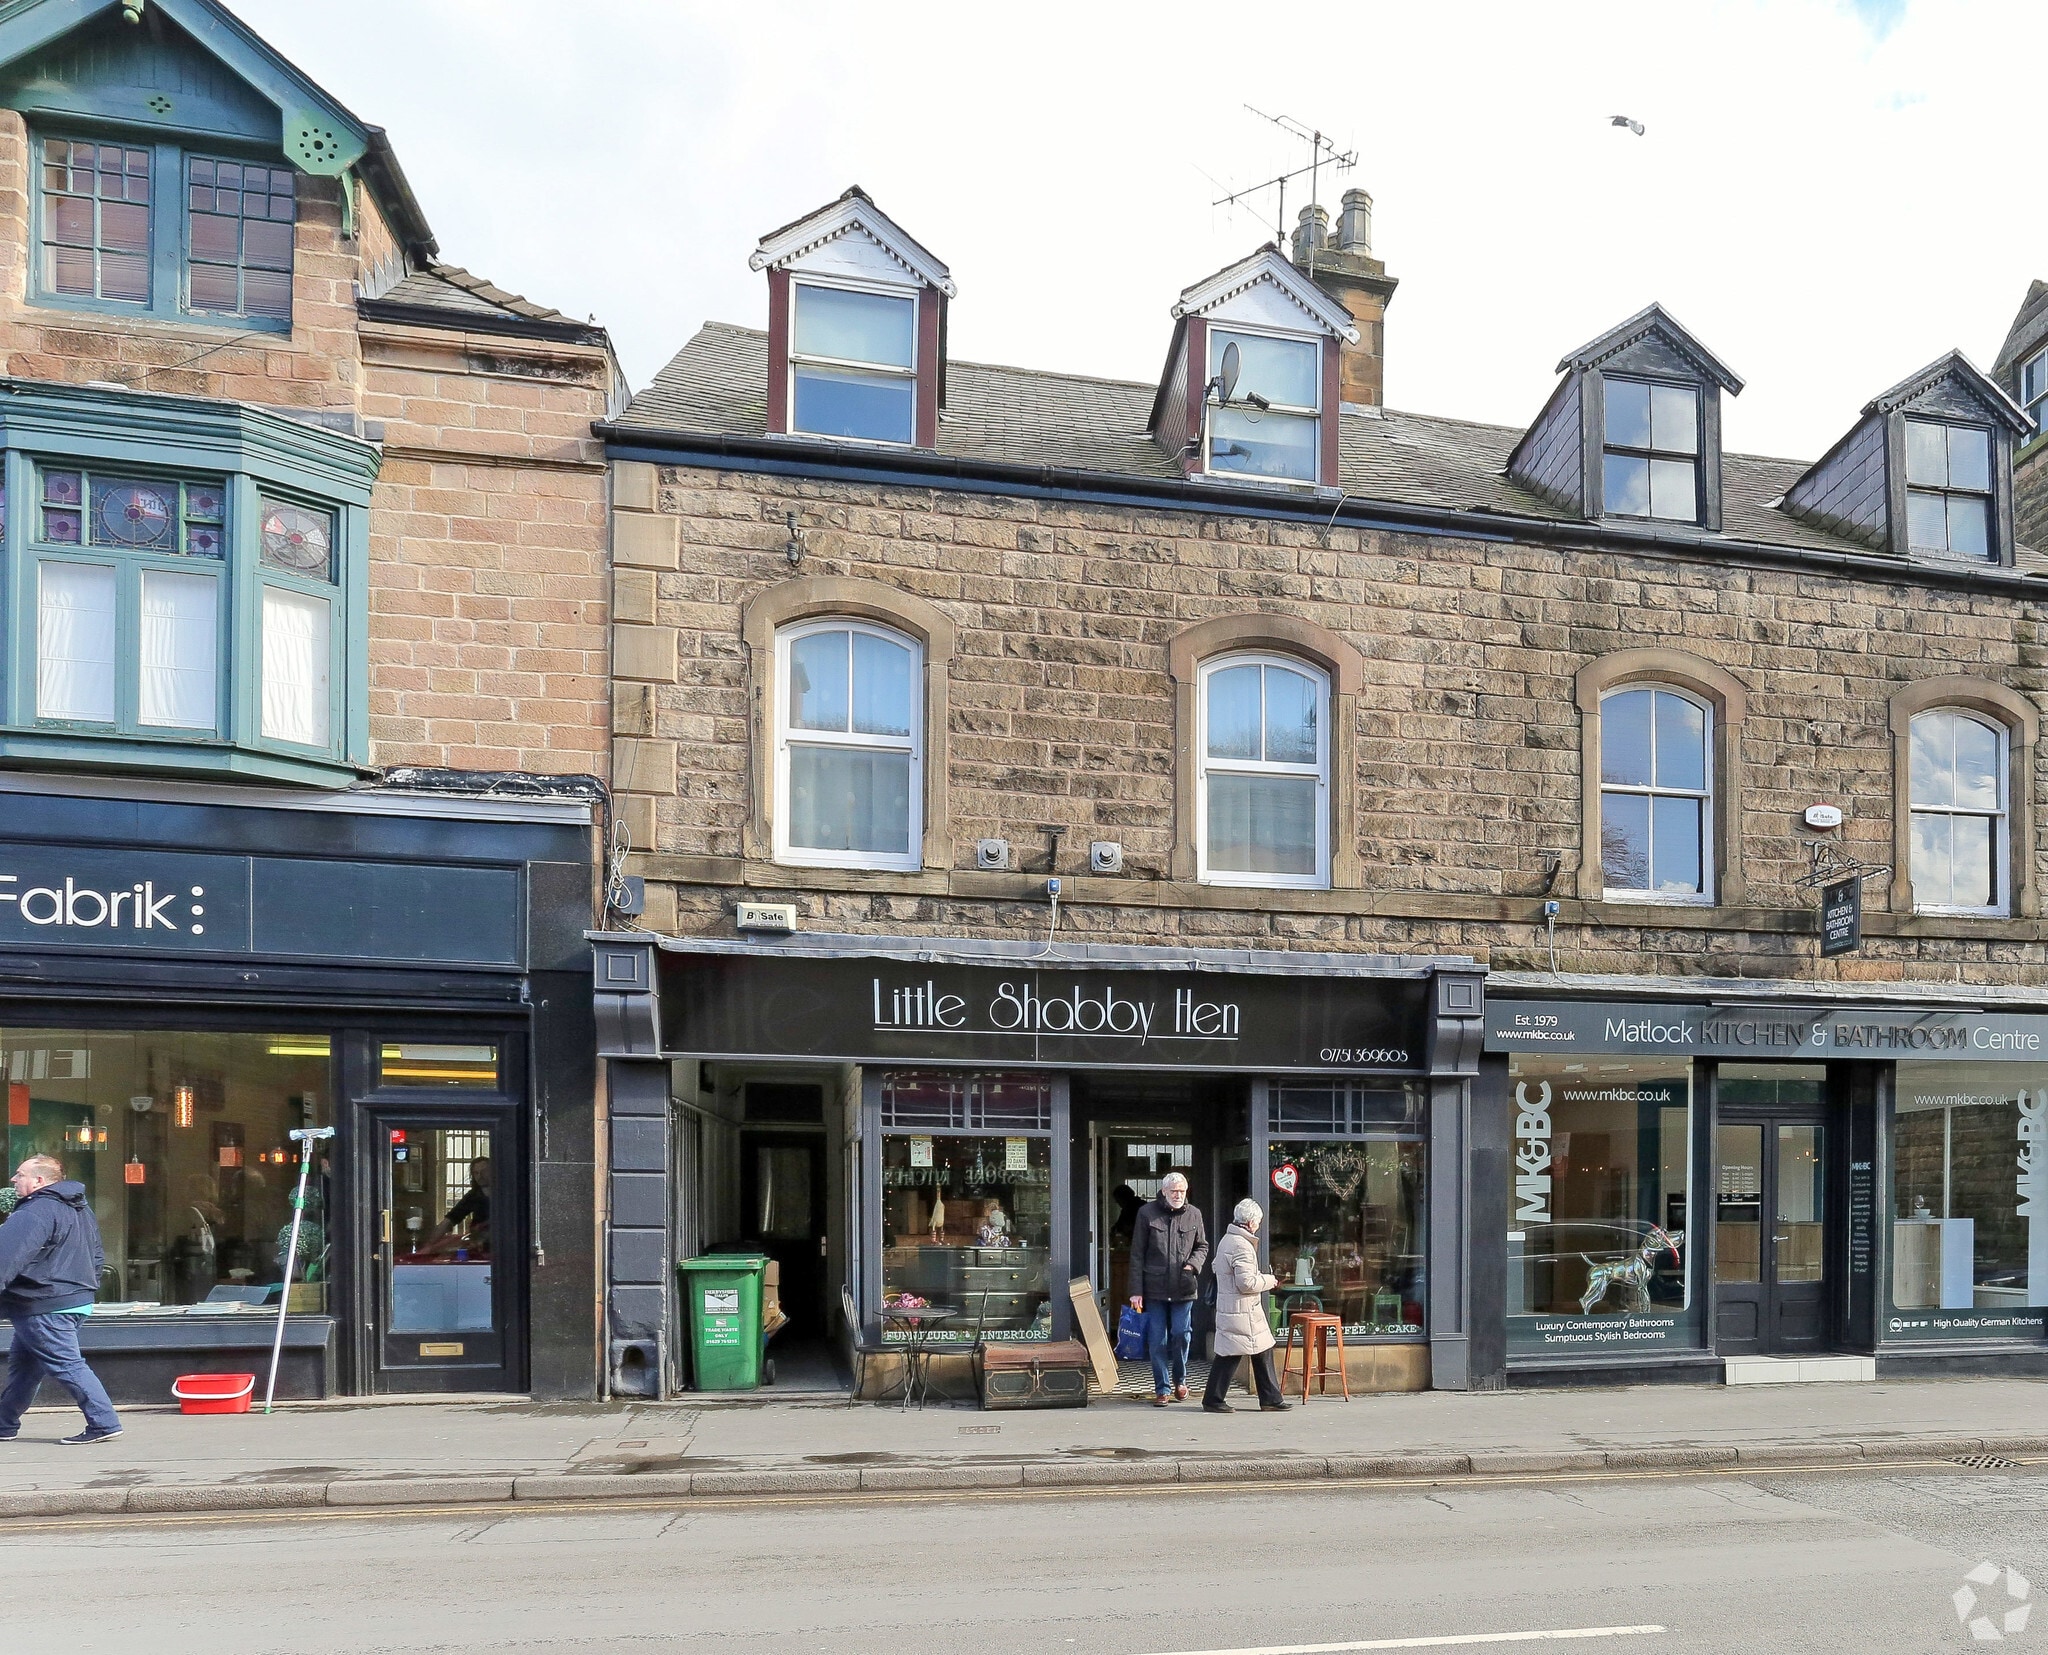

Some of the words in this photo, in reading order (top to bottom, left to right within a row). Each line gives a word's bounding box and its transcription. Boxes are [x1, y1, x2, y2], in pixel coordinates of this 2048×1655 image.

[747, 912, 754, 920] B
[761, 912, 784, 920] Safe
[1828, 905, 1849, 919] KITCHEN
[1849, 904, 1853, 913] &
[1826, 915, 1854, 930] BATHROOM
[1830, 927, 1849, 940] CENTRE
[873, 978, 966, 1027] Little
[990, 982, 1155, 1046] Shabby
[1175, 988, 1240, 1034] Hen
[1534, 1015, 1558, 1027] 1979
[1496, 1030, 1575, 1041] www.mkbc.co.uk
[1604, 1018, 1693, 1044] Matlock
[1701, 1020, 1804, 1046] KITCHEN
[1811, 1023, 1827, 1046] &
[1835, 1024, 1967, 1049] BATHROOM
[1973, 1026, 2040, 1050] Centre
[1320, 1048, 1351, 1062] 07751
[1563, 1088, 1671, 1102] www.mkbc.co.uk
[1914, 1093, 2009, 1105] www.mkbc.co.uk
[1515, 1080, 1552, 1223] MK&BC
[1387, 1324, 1417, 1334] CAKE
[1535, 1322, 1564, 1331] Luxury
[1566, 1320, 1627, 1330] Contemporary
[1629, 1319, 1674, 1328] Bathrooms
[1933, 1319, 1952, 1329] High
[1952, 1318, 1979, 1329] Quality
[1980, 1318, 2010, 1327] German
[2011, 1316, 2043, 1326] Kitchens
[981, 1330, 1049, 1340] INTERIORS
[1545, 1333, 1593, 1343] Sumptuous
[1594, 1332, 1621, 1342] Stylish
[1623, 1330, 1665, 1340] Bedrooms
